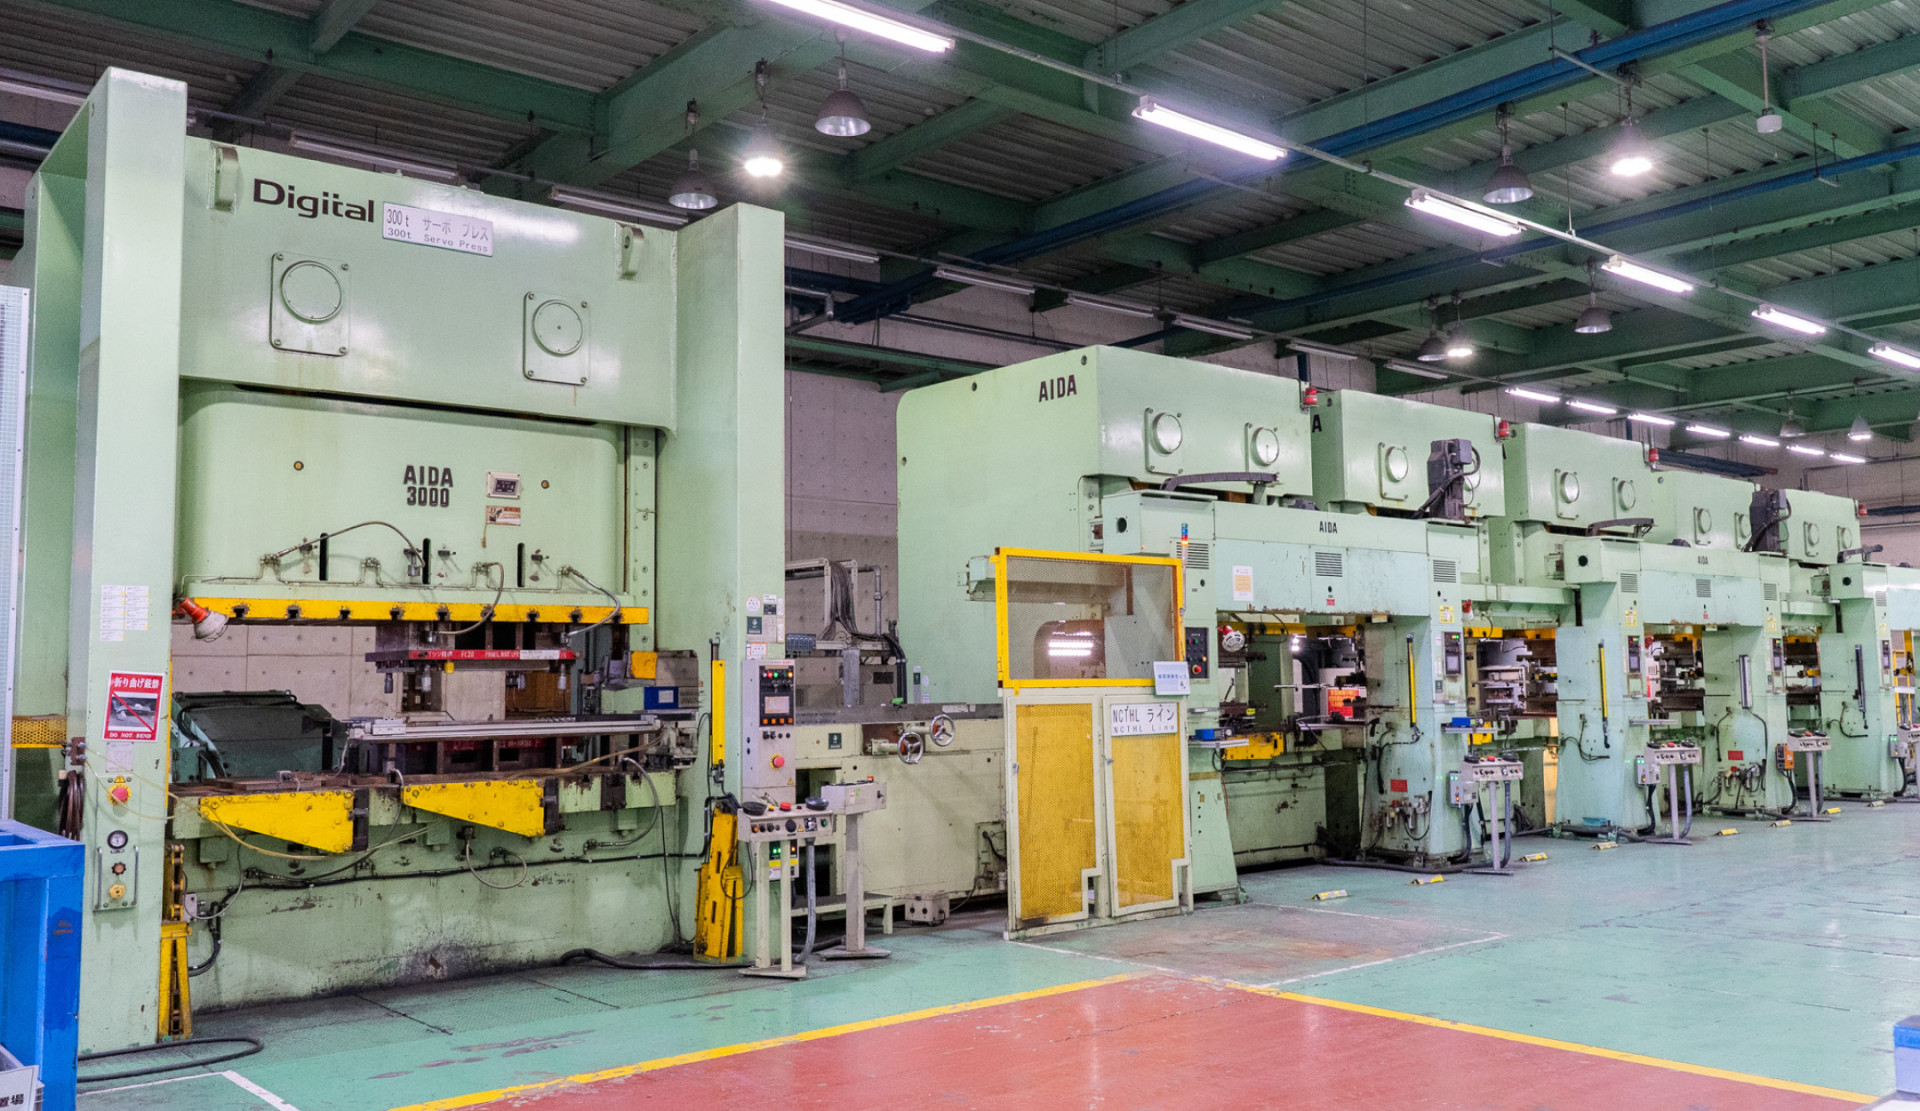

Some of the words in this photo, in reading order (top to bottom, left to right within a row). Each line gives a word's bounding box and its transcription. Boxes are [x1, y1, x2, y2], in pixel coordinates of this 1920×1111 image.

[253, 178, 375, 223] Digital
[387, 227, 412, 240] 300t
[424, 234, 454, 247] Servo
[459, 240, 489, 253] Press
[1039, 374, 1078, 403] AIDA
[403, 464, 454, 488] AIDA
[407, 486, 450, 508] 3000
[1319, 520, 1338, 534] AIDA
[114, 677, 160, 689] 折り曲げ厳禁
[1113, 707, 1140, 723] NCTHL
[1147, 707, 1175, 723] ライン
[1114, 724, 1143, 734] NCTHL
[1151, 724, 1175, 733] Line
